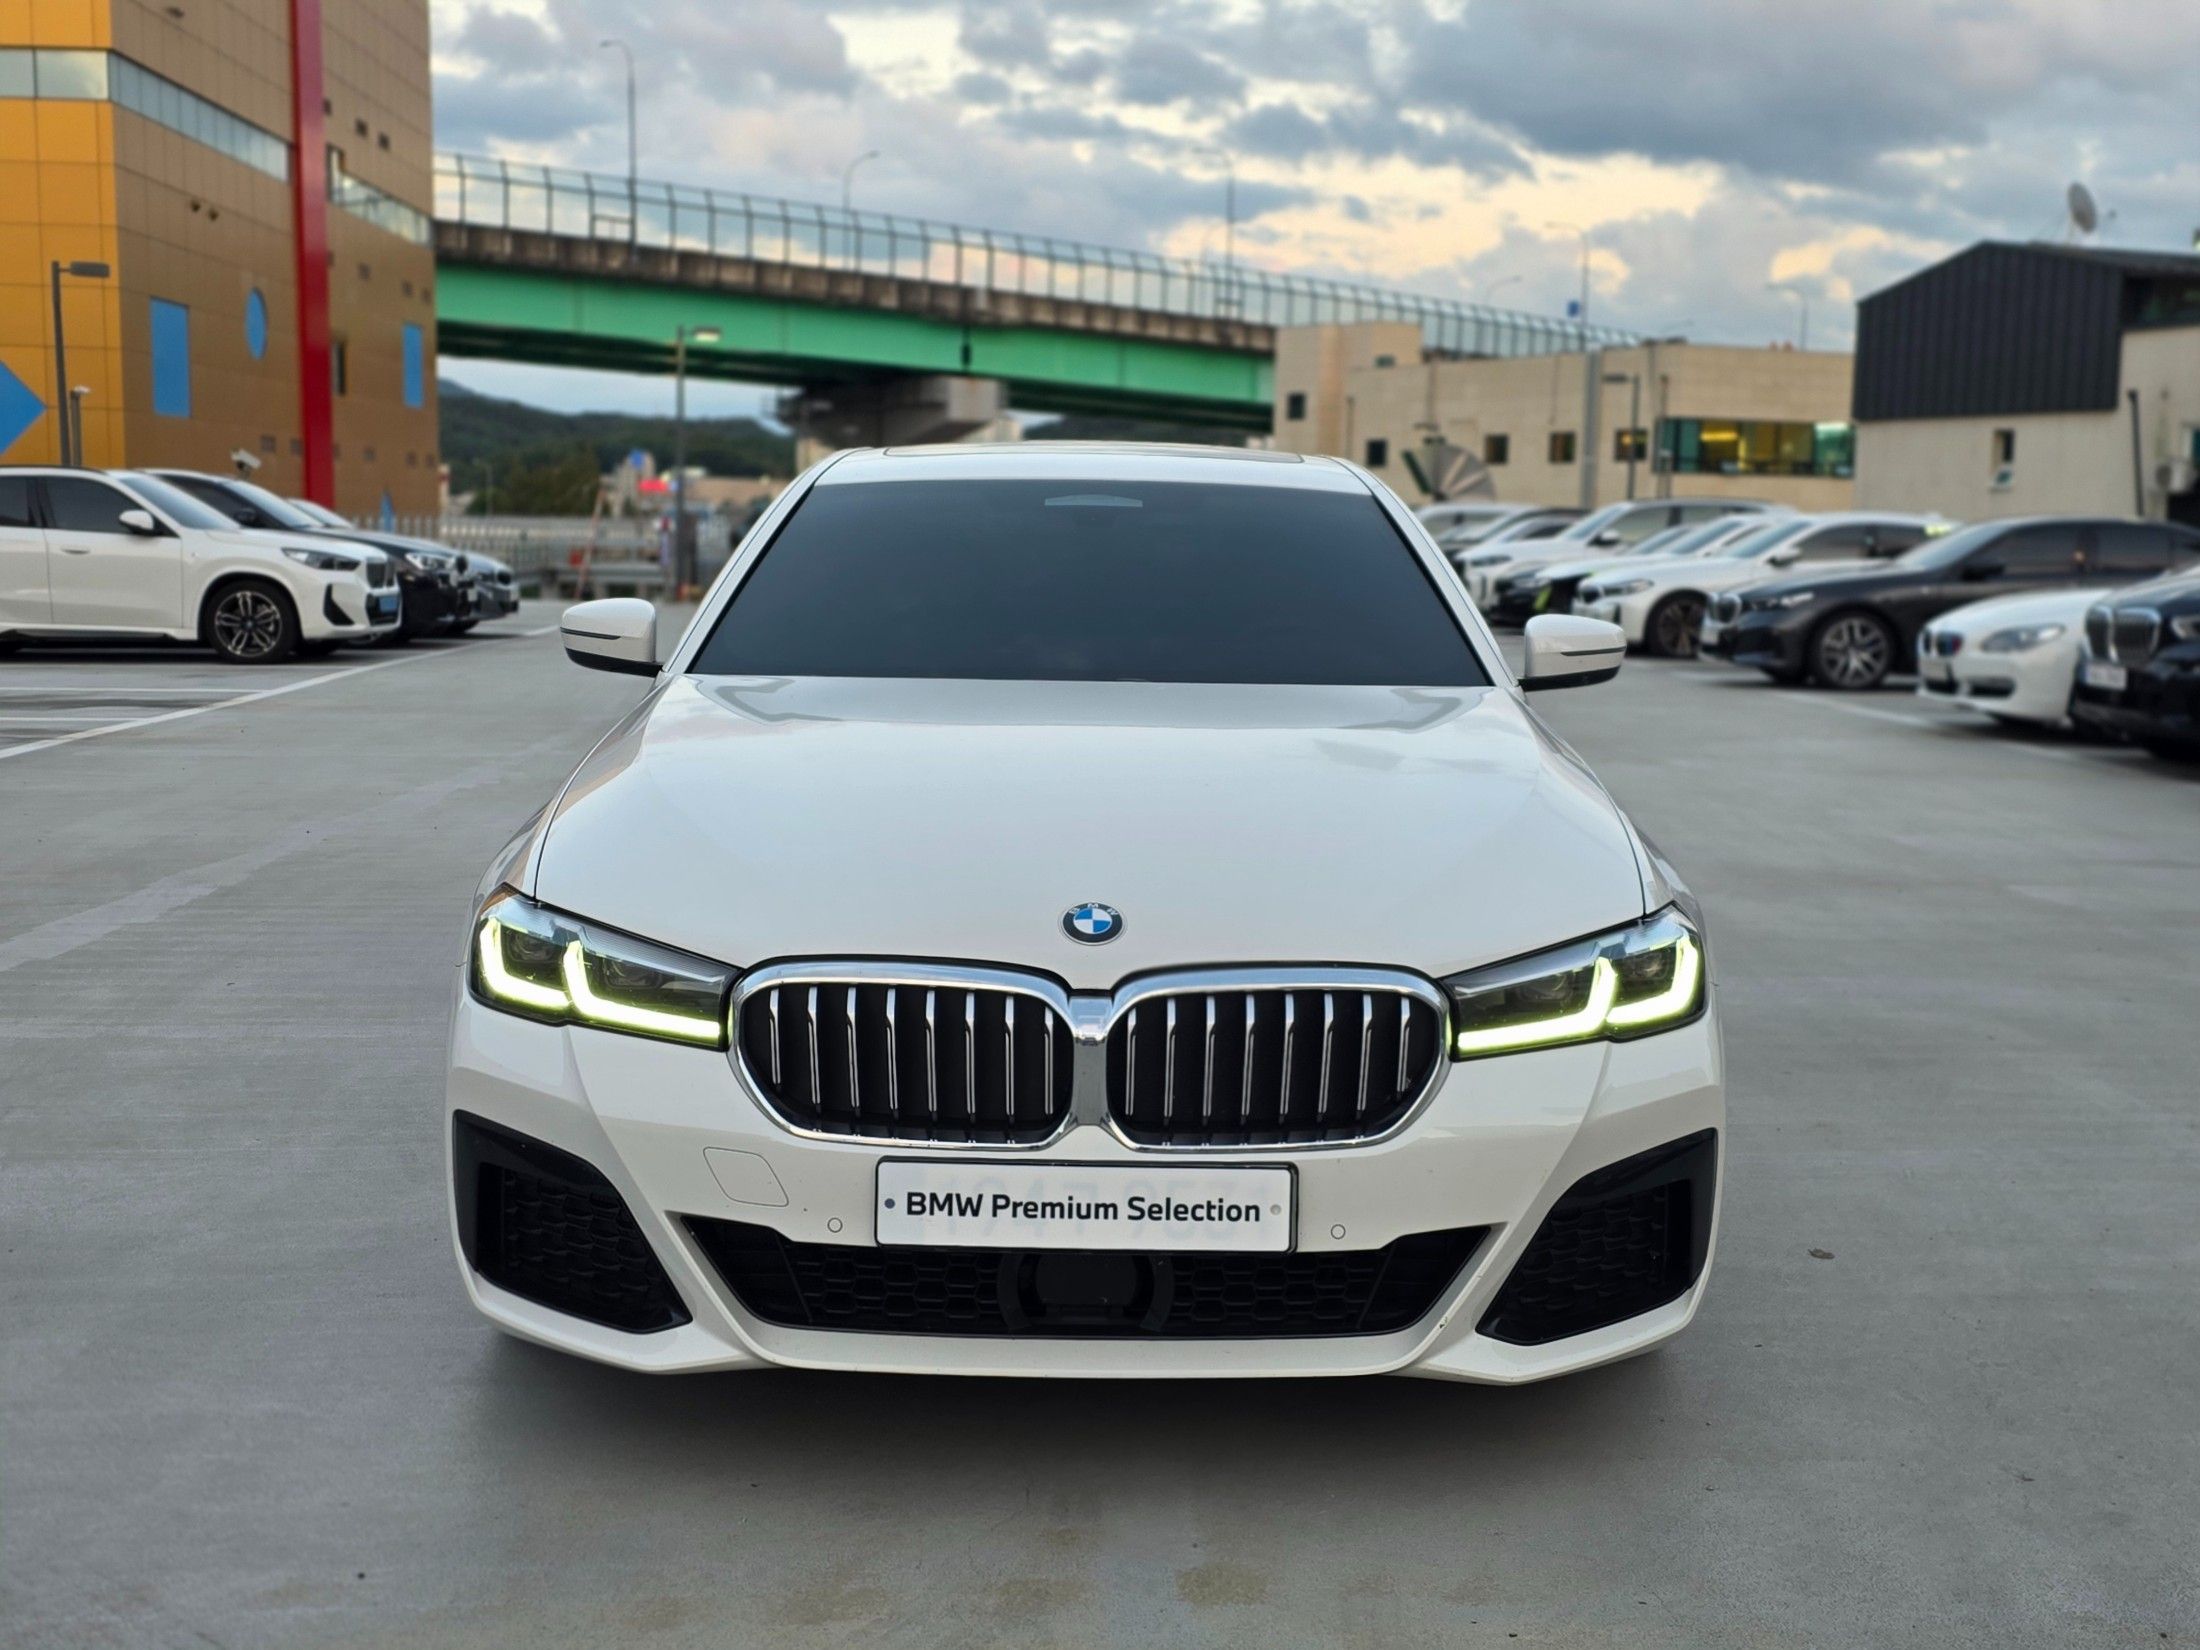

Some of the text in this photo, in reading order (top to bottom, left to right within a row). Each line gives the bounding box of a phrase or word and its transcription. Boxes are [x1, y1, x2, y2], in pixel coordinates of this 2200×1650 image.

[906, 1191, 984, 1218] BMW
[991, 1193, 1118, 1220] Premium
[1127, 1196, 1260, 1222] Selection
